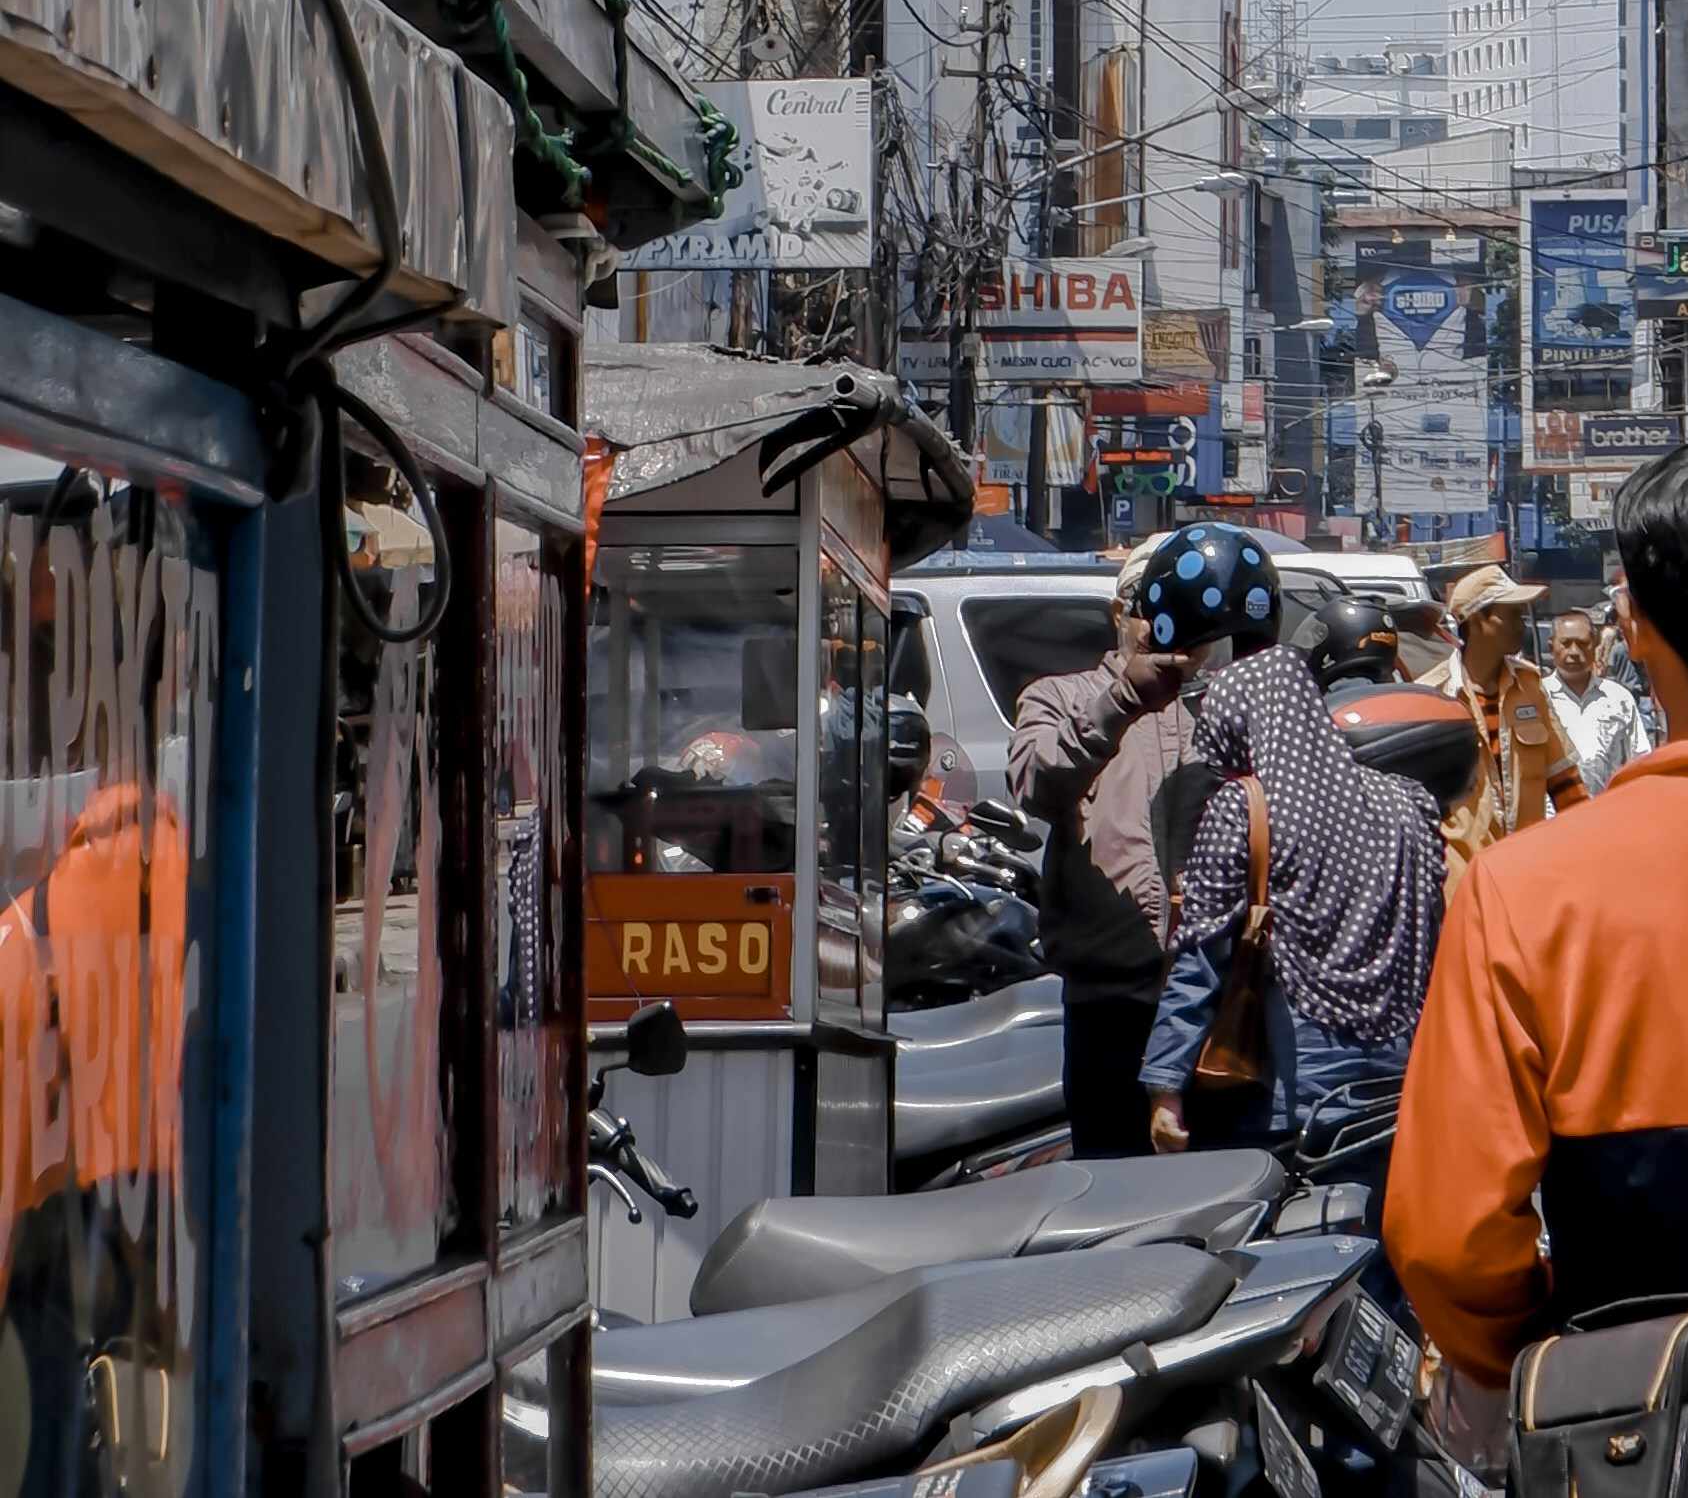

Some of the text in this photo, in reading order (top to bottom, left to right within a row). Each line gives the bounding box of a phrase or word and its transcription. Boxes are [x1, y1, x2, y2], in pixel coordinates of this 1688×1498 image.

[766, 87, 853, 117] Central
[651, 228, 806, 262] PYRAMID
[942, 272, 1137, 312] SHIBA
[902, 357, 921, 369] TV
[1000, 355, 1038, 369] MESIN
[1041, 355, 1072, 369] CUCI
[1080, 357, 1101, 369] AC
[1110, 357, 1137, 369] VCD
[1541, 348, 1594, 362] PINTU
[1590, 426, 1671, 448] brother
[1115, 499, 1130, 518] P
[622, 921, 769, 976] RASO
